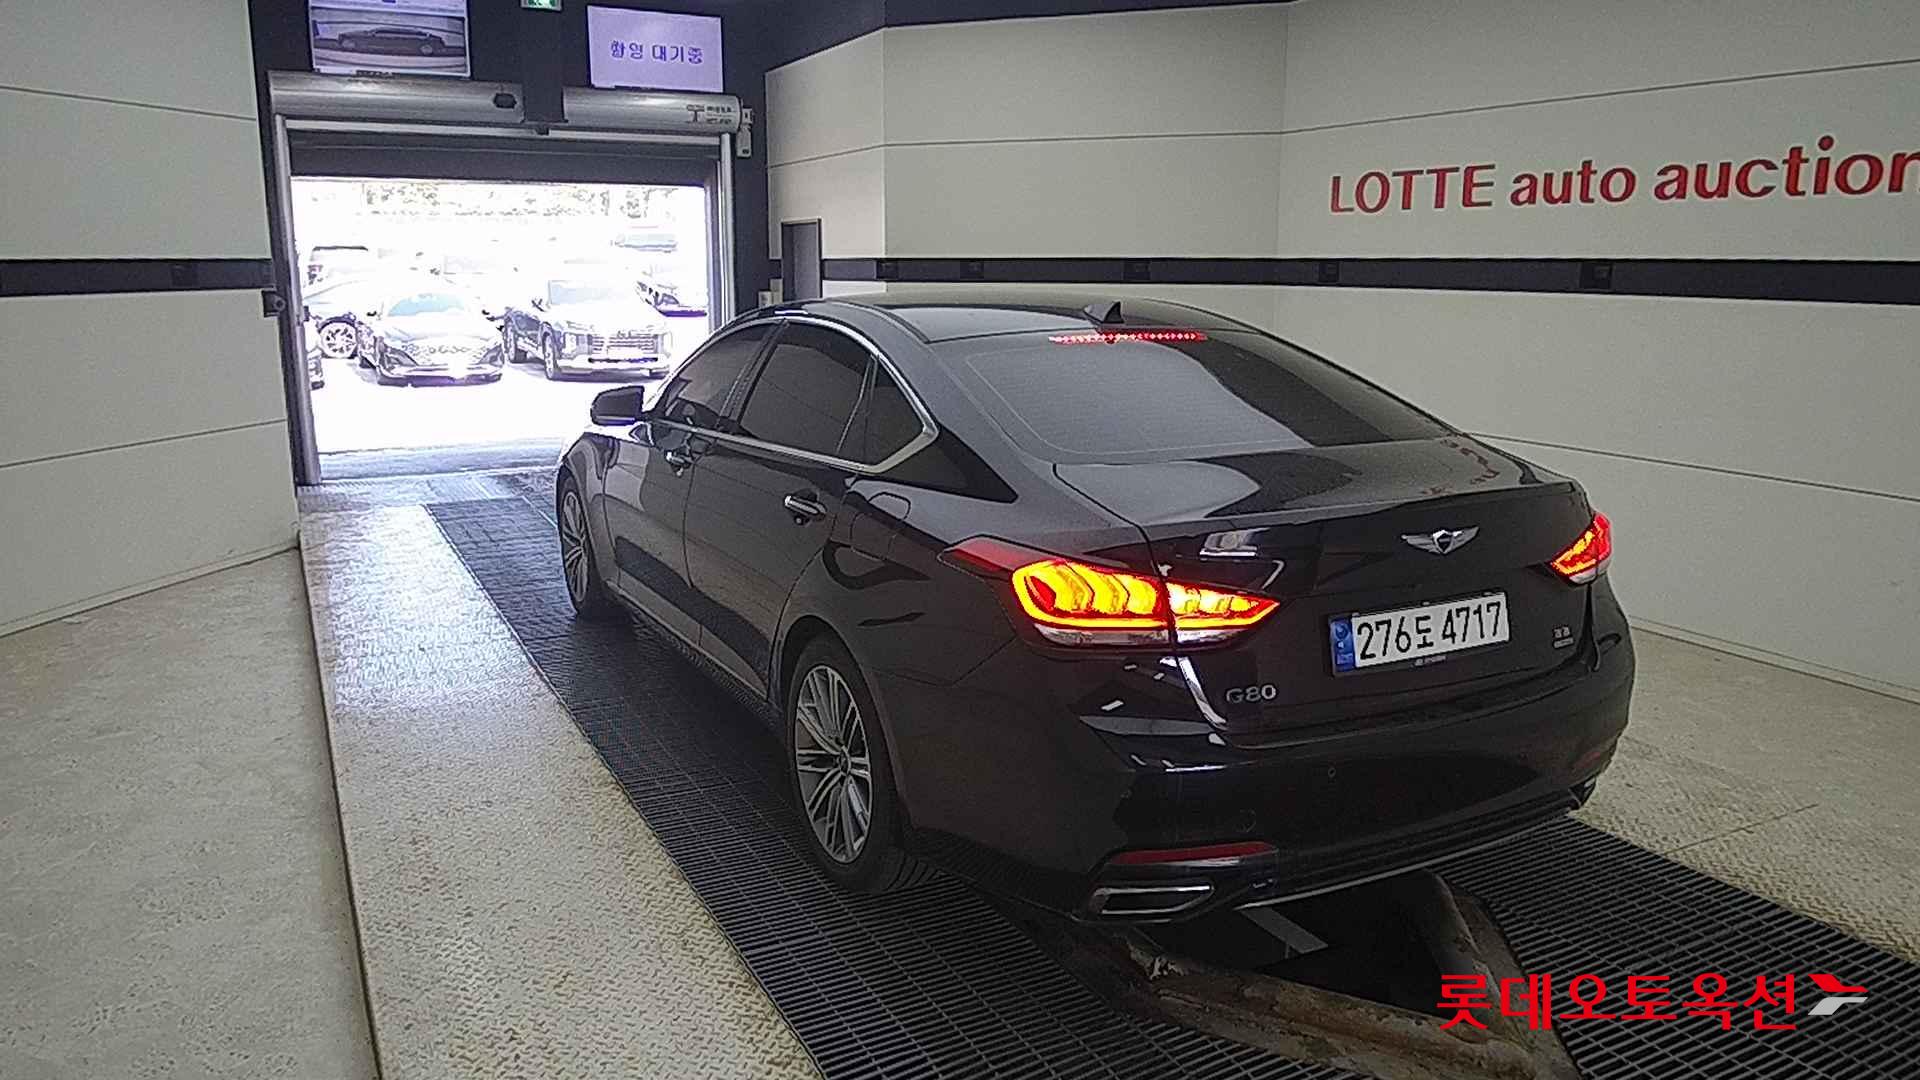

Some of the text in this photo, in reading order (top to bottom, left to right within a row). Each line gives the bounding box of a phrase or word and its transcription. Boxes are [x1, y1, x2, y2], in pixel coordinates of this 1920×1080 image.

[652, 44, 703, 65] 대기중
[1330, 164, 1496, 213] LOTTE
[1510, 159, 1637, 206] auto
[1226, 684, 1277, 703] G80
